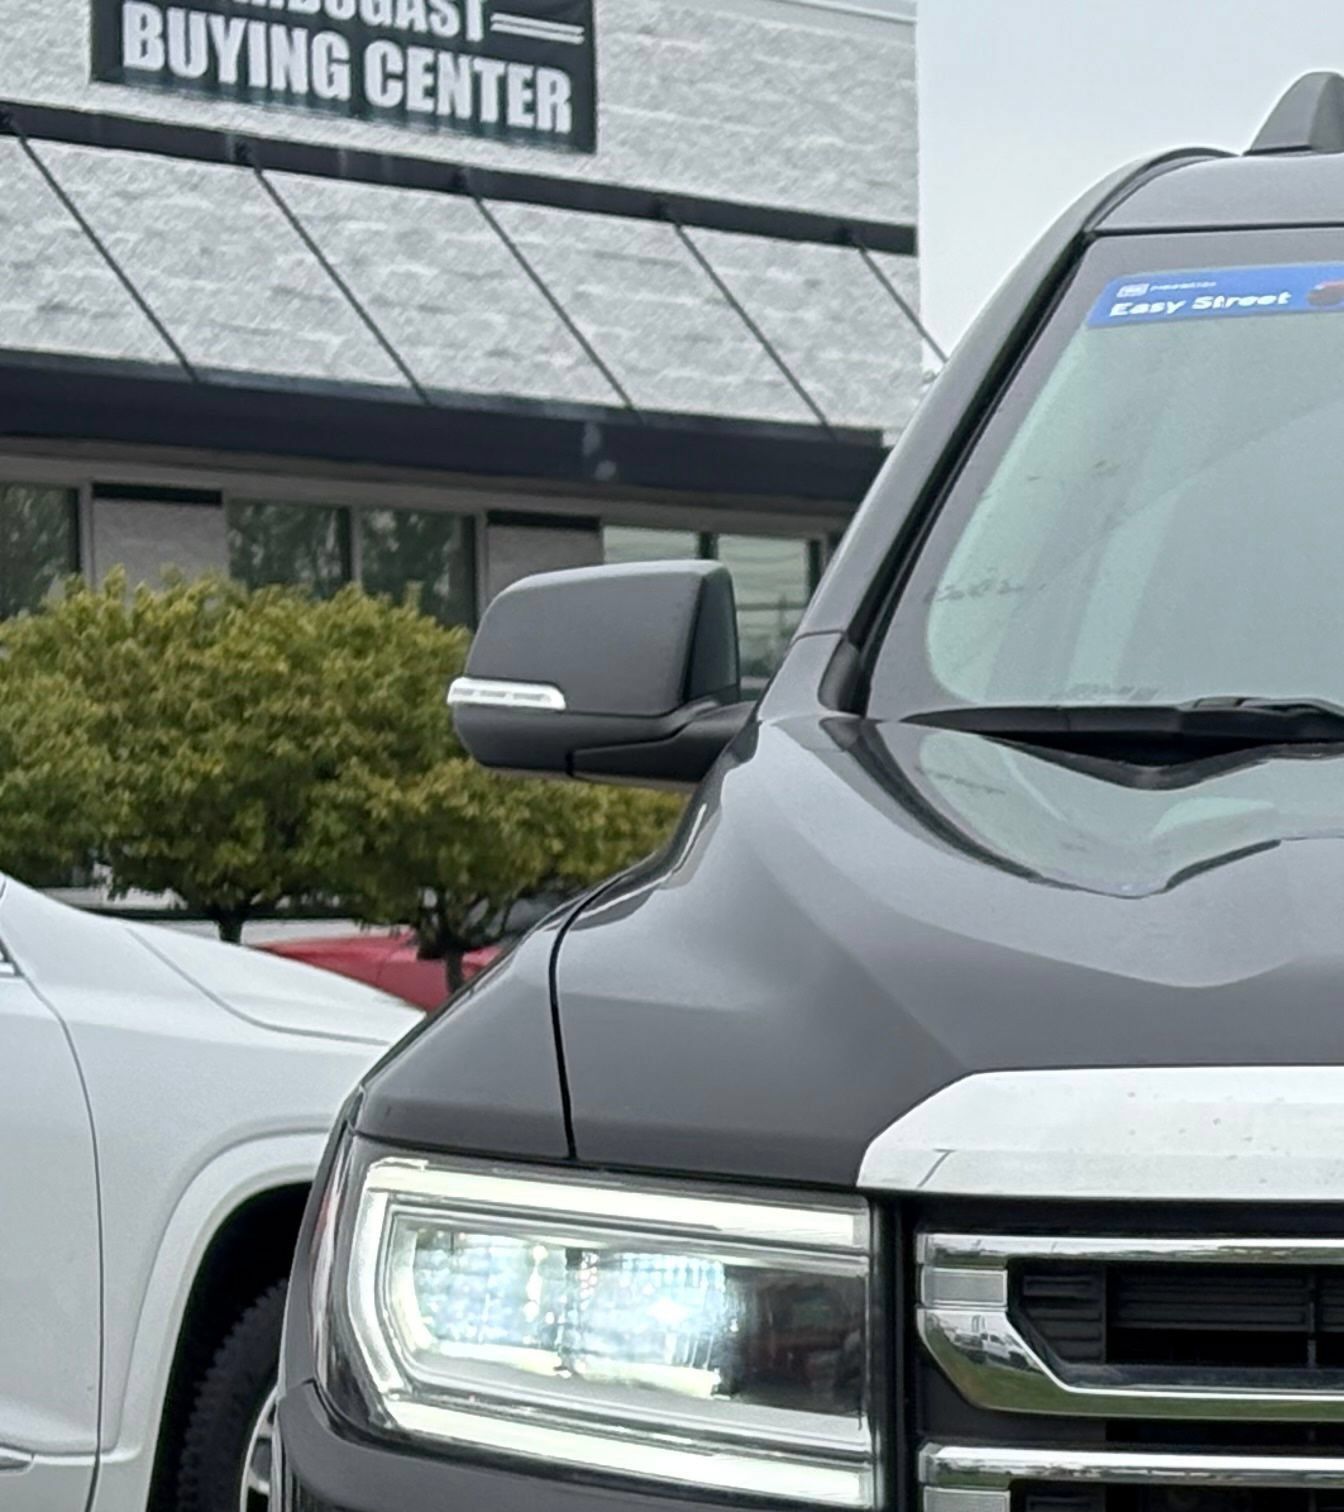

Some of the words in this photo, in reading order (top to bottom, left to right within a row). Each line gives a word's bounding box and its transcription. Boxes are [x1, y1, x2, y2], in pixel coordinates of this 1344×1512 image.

[231, 0, 486, 42] GAST
[121, 1, 351, 101] BUYING
[363, 39, 573, 133] CENTER
[1109, 301, 1186, 317] Easy
[1191, 291, 1292, 310] Street
